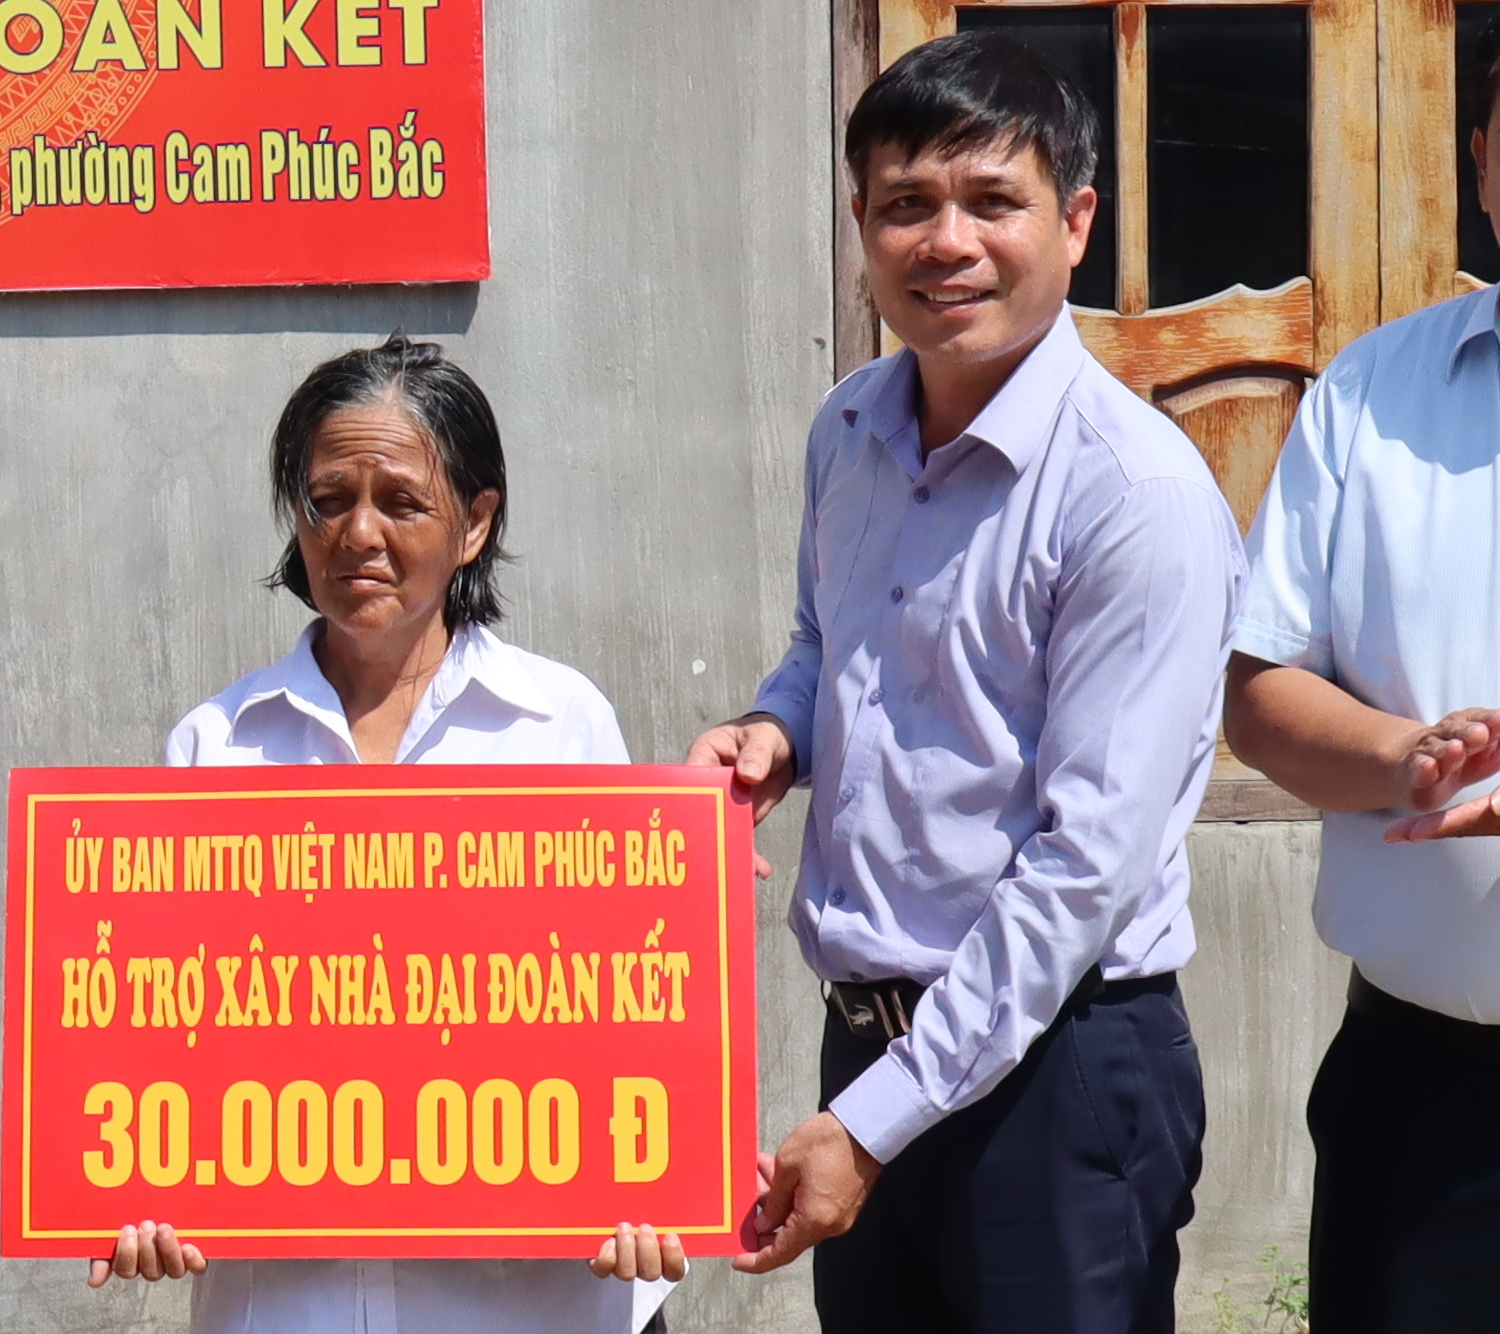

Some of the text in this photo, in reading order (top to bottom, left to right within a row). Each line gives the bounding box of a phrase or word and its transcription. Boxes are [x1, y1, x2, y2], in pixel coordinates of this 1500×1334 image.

[10, 132, 155, 215] phường
[165, 131, 250, 203] Cam
[261, 128, 358, 201] Phúc
[369, 110, 443, 198] Bắc
[66, 809, 685, 902] ỦY BAN MTTQ VIỆT NAM P. CAM PHÚC BẮC
[62, 918, 689, 1047] HỖ TRỢ XÂY NHÀ ĐẠI ĐOÀN KẾT
[84, 1078, 668, 1187] 30.000.000 Đ
